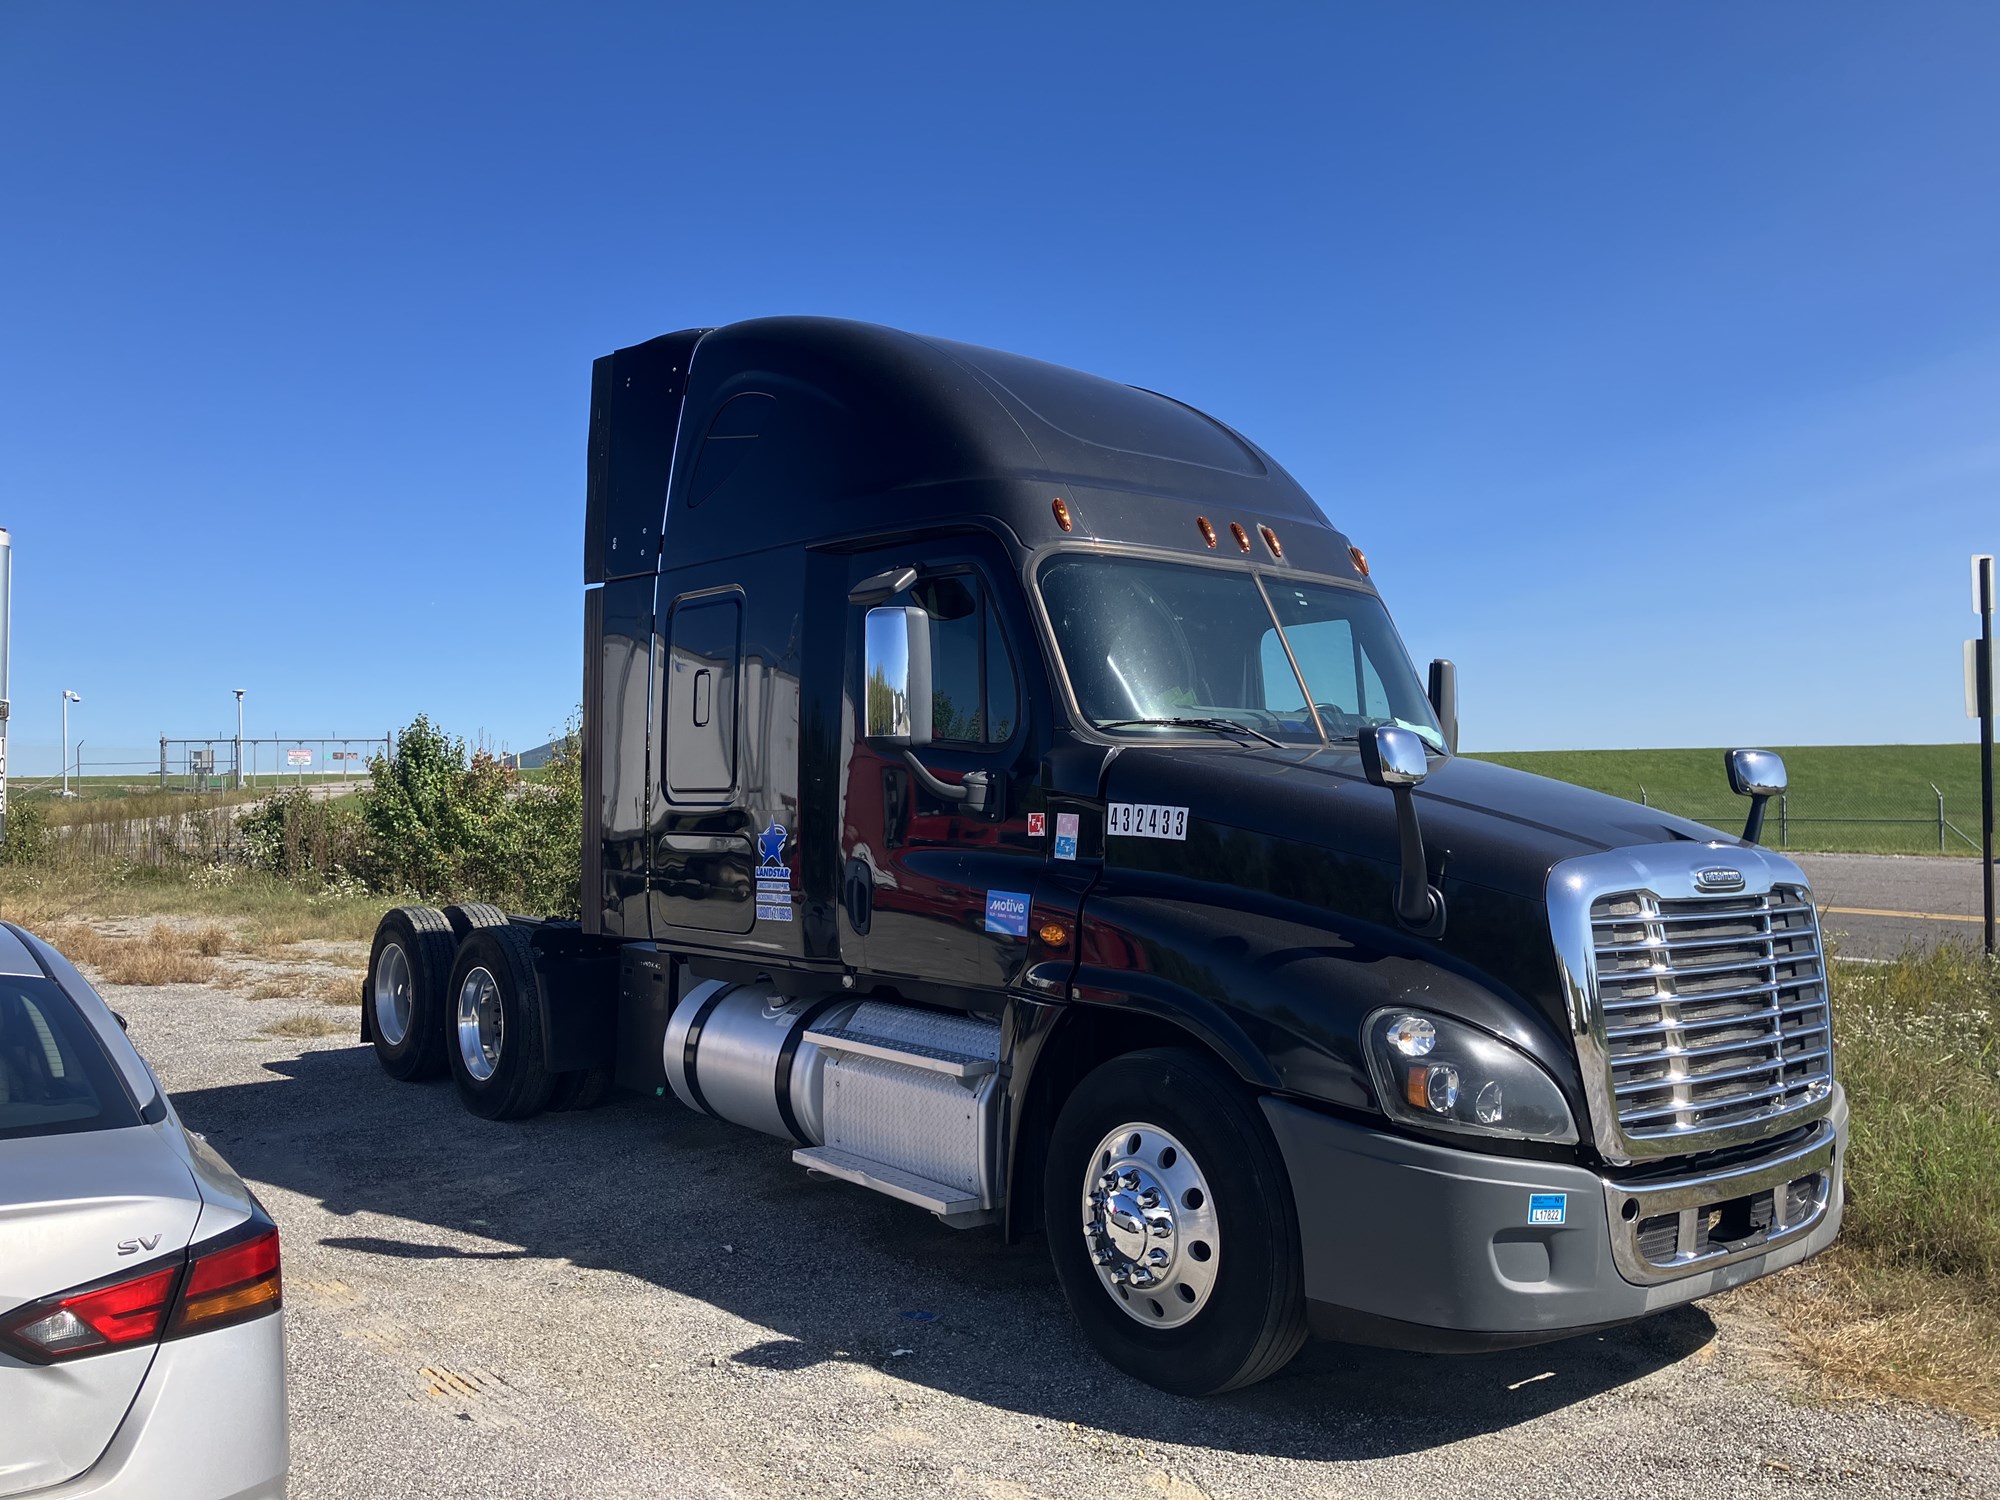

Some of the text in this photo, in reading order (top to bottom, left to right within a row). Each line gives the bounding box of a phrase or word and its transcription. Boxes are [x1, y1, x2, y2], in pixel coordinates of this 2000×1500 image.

[1110, 807, 1184, 836] 432433
[756, 867, 790, 878] LANDSTAR
[990, 899, 1024, 913] Motive
[1555, 1196, 1564, 1204] NY
[1535, 1209, 1559, 1220] L17822
[117, 1234, 162, 1256] SV
